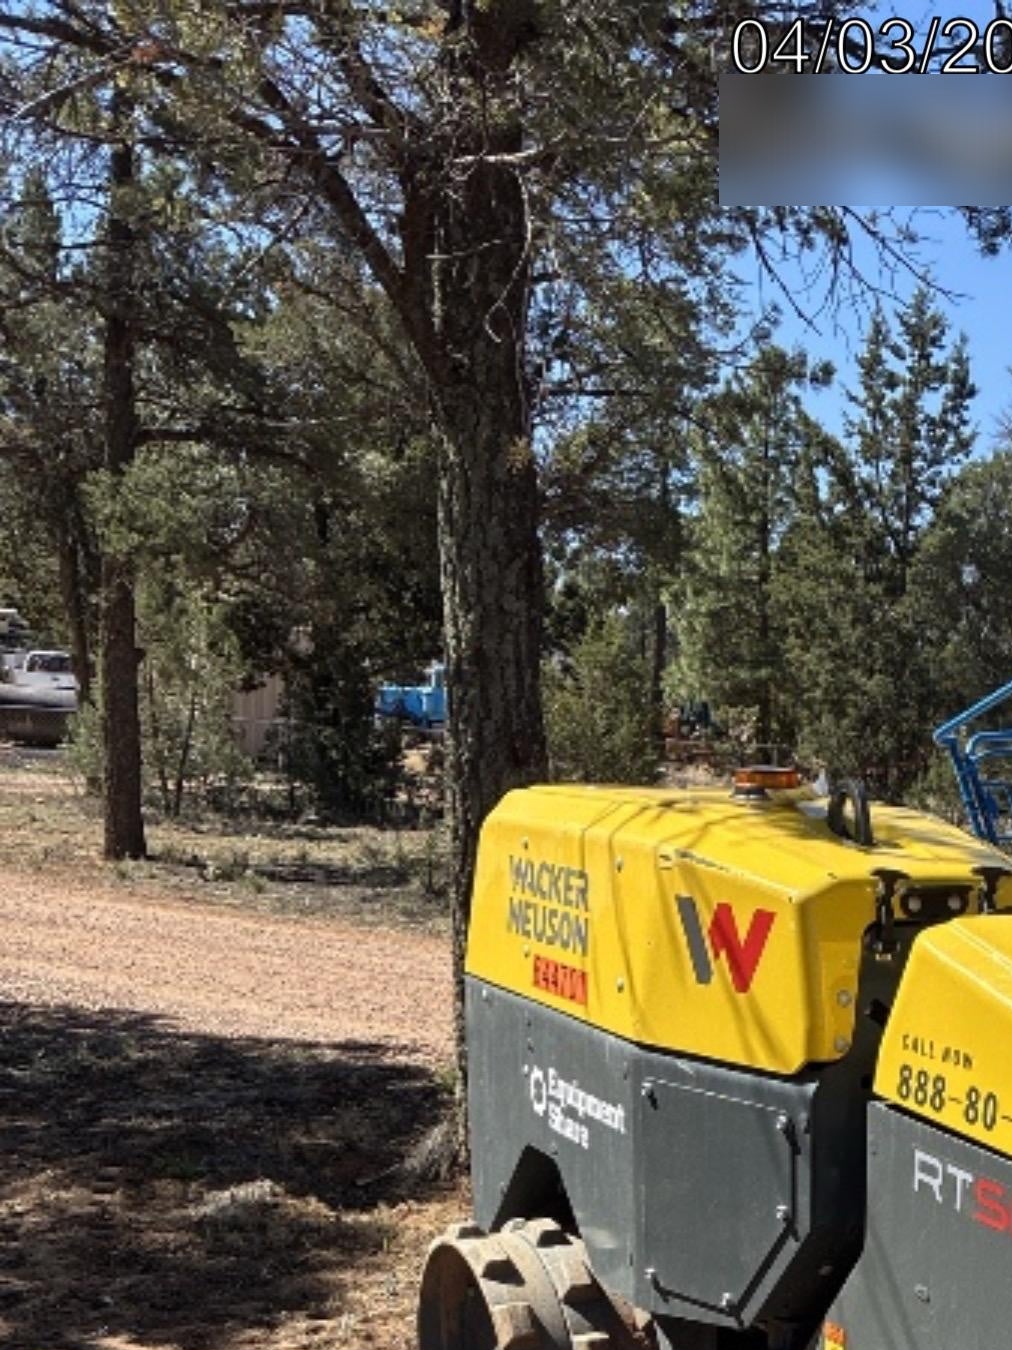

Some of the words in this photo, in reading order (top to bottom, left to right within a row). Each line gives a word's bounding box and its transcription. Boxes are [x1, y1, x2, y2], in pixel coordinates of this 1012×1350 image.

[509, 855, 588, 912] WACKER
[508, 897, 588, 957] NEUSON
[902, 1034, 935, 1060] CALL
